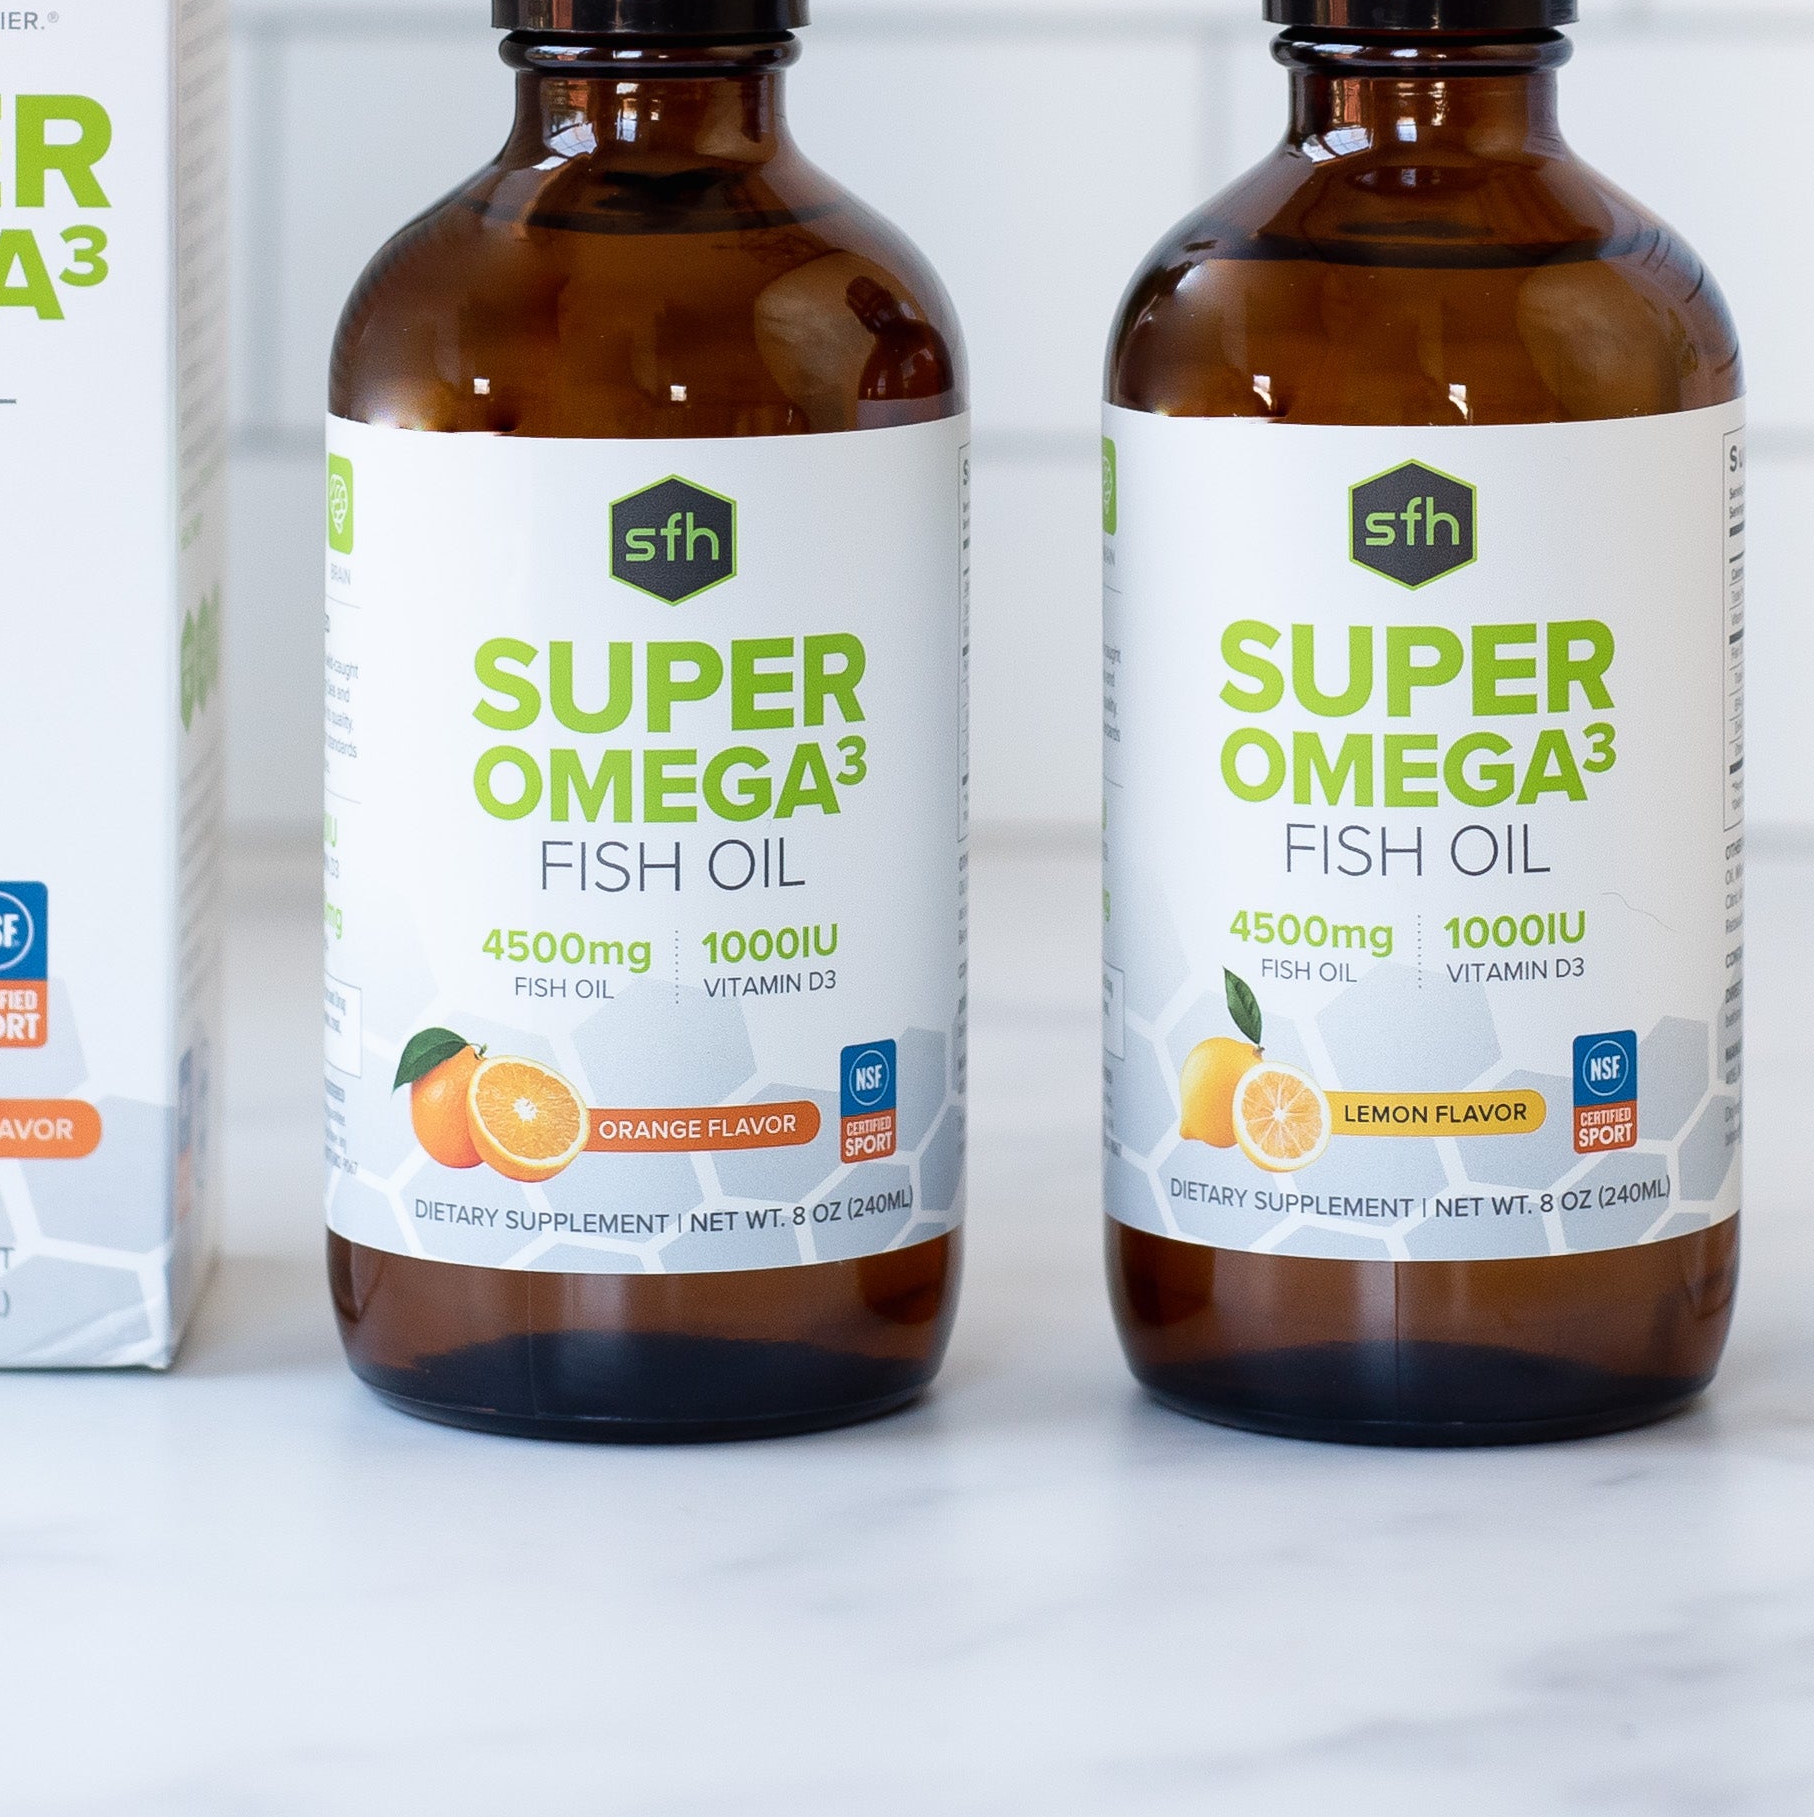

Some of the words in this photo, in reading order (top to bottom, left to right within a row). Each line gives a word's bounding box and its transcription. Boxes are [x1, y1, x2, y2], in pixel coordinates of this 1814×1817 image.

[625, 512, 719, 563] sfh
[1365, 496, 1459, 547] sfh
[472, 632, 867, 734] SUPER
[1219, 618, 1615, 718] SUPER
[542, 840, 682, 893] FISH
[708, 837, 806, 890] OIL
[1286, 823, 1423, 876] FISH
[1450, 823, 1551, 875] OIL
[702, 922, 839, 965] 1000IU
[1229, 910, 1394, 958] 4500mg
[1443, 910, 1587, 950] 1000IU
[482, 928, 652, 974] 4500mg
[703, 972, 802, 999] VITAMIN
[808, 970, 837, 992] D3
[1261, 958, 1314, 982] FISH
[1319, 960, 1357, 983] OIL
[1446, 959, 1549, 984] VITAMIN
[1555, 957, 1585, 979] D3
[514, 976, 567, 999] FISH
[575, 977, 615, 1000] OIL
[855, 1064, 883, 1092] NSF
[1590, 1055, 1621, 1083] NSF
[598, 1118, 702, 1141] ORANGE
[708, 1113, 796, 1138] FLAVOR
[846, 1115, 892, 1137] CERTIFIED
[1344, 1103, 1428, 1125] LEMON
[1435, 1102, 1527, 1124] FLAVOR
[1580, 1107, 1632, 1129] CERTIFIED
[845, 1131, 893, 1157] SPORT
[1578, 1123, 1633, 1149] SPORT
[414, 1197, 499, 1230] DIETARY
[505, 1208, 670, 1235] SUPPLEMENT
[690, 1209, 738, 1233] NET
[746, 1205, 787, 1231] WT.
[792, 1206, 806, 1227] 8
[813, 1200, 841, 1224] OZ
[847, 1183, 914, 1224] (240ML)
[1171, 1178, 1248, 1209] DIETARY
[1254, 1189, 1413, 1218] SUPPLEMENT
[1435, 1197, 1484, 1218] NET
[1492, 1194, 1534, 1217] WT.
[1540, 1193, 1555, 1213] 8
[1560, 1189, 1592, 1211] OZ
[1597, 1174, 1672, 1210] (240ML)
